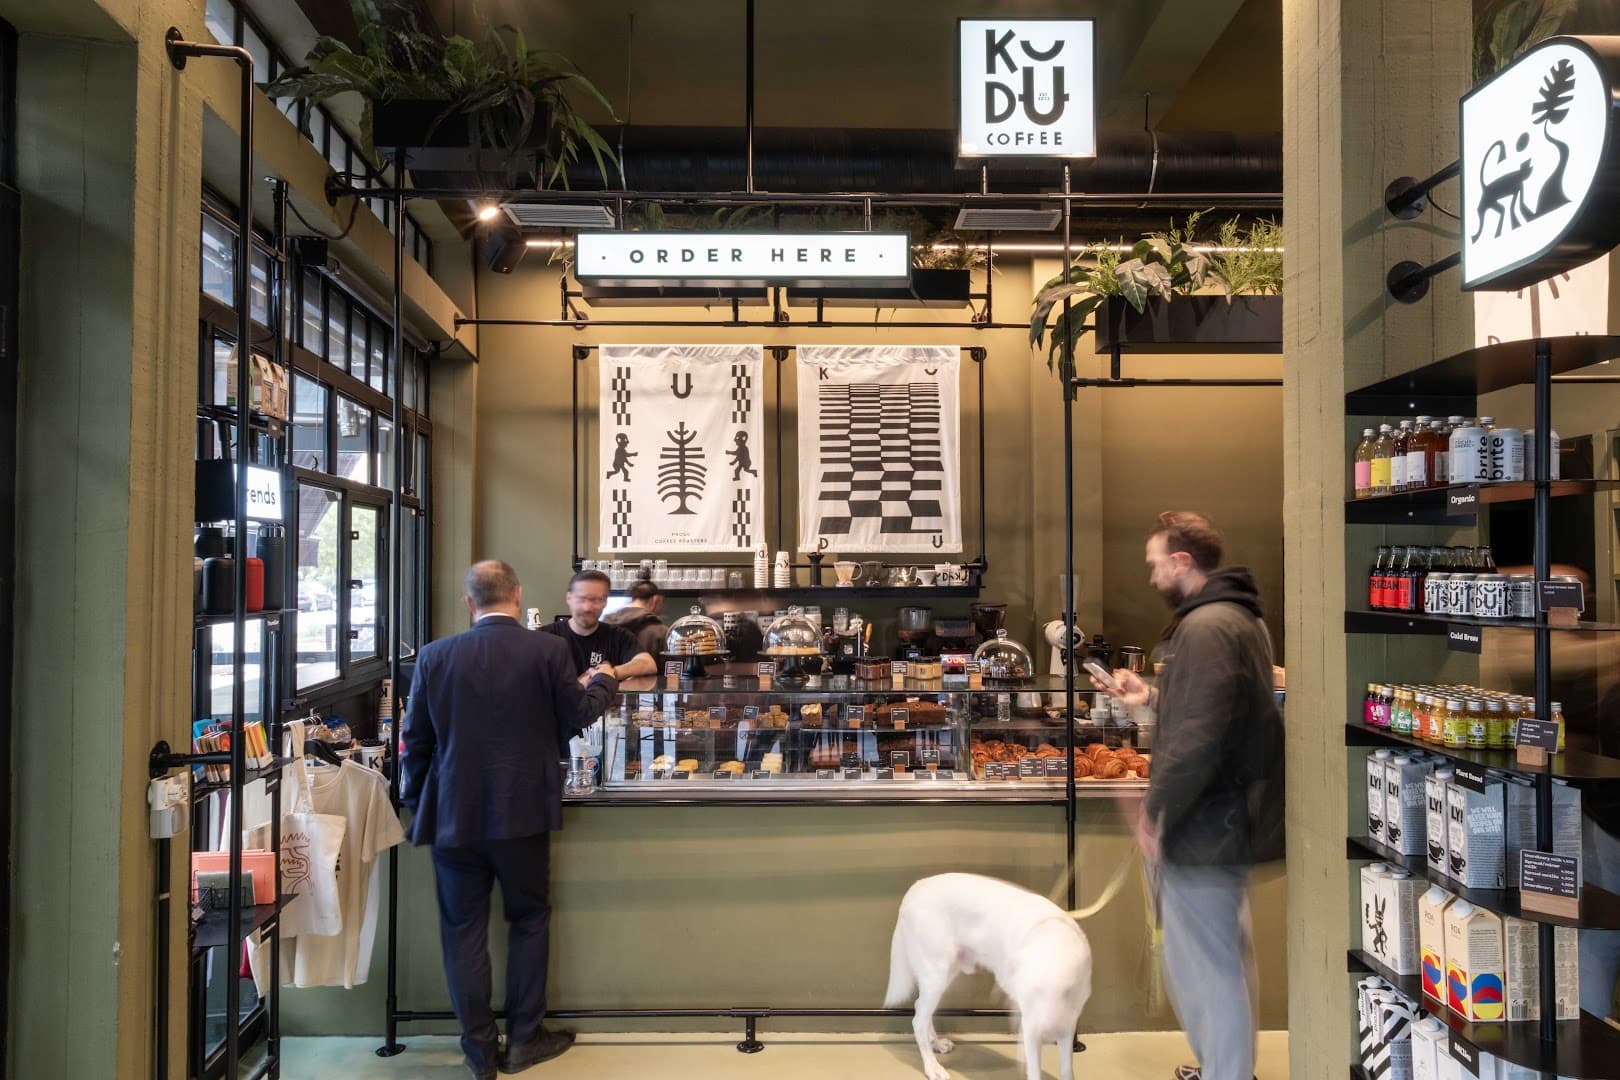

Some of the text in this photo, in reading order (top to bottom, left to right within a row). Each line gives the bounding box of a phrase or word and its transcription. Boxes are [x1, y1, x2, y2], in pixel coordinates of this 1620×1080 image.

[986, 131, 1063, 146] COFFEE
[629, 248, 856, 264] ORDER HERE
[1474, 436, 1488, 480] brite
[1487, 437, 1505, 481] brite
[1450, 494, 1476, 505] Organic
[1450, 631, 1479, 642] Cold Brew
[1369, 775, 1381, 790] LY!
[1388, 782, 1399, 798] LY!
[1429, 797, 1442, 814] LY!
[1450, 805, 1464, 824] LY!
